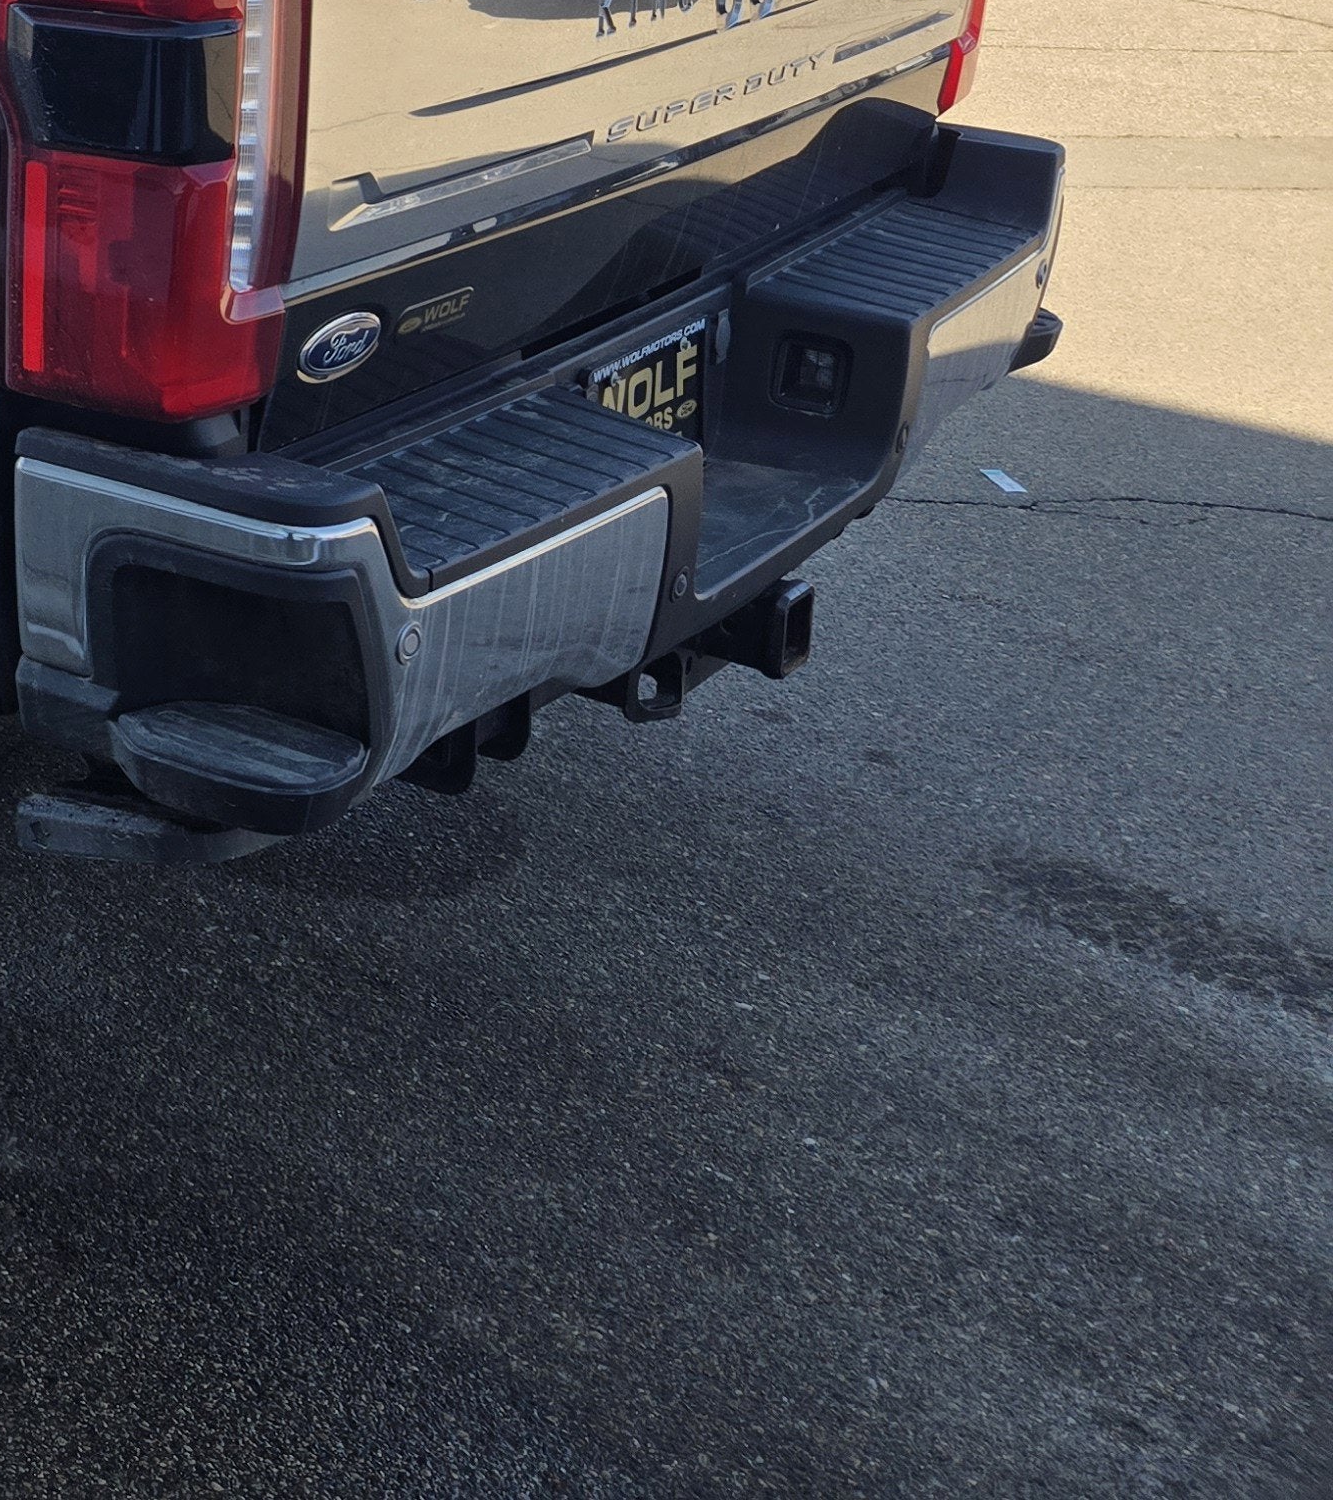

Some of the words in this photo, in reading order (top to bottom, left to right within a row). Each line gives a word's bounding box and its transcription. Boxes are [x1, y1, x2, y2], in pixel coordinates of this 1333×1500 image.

[607, 82, 737, 143] SUPER
[743, 50, 827, 96] DUTY
[424, 293, 470, 324] WOLF
[323, 326, 370, 366] Ford
[593, 318, 706, 383] WWW.WOLFMOTORS.COM
[602, 344, 698, 419] WOLF
